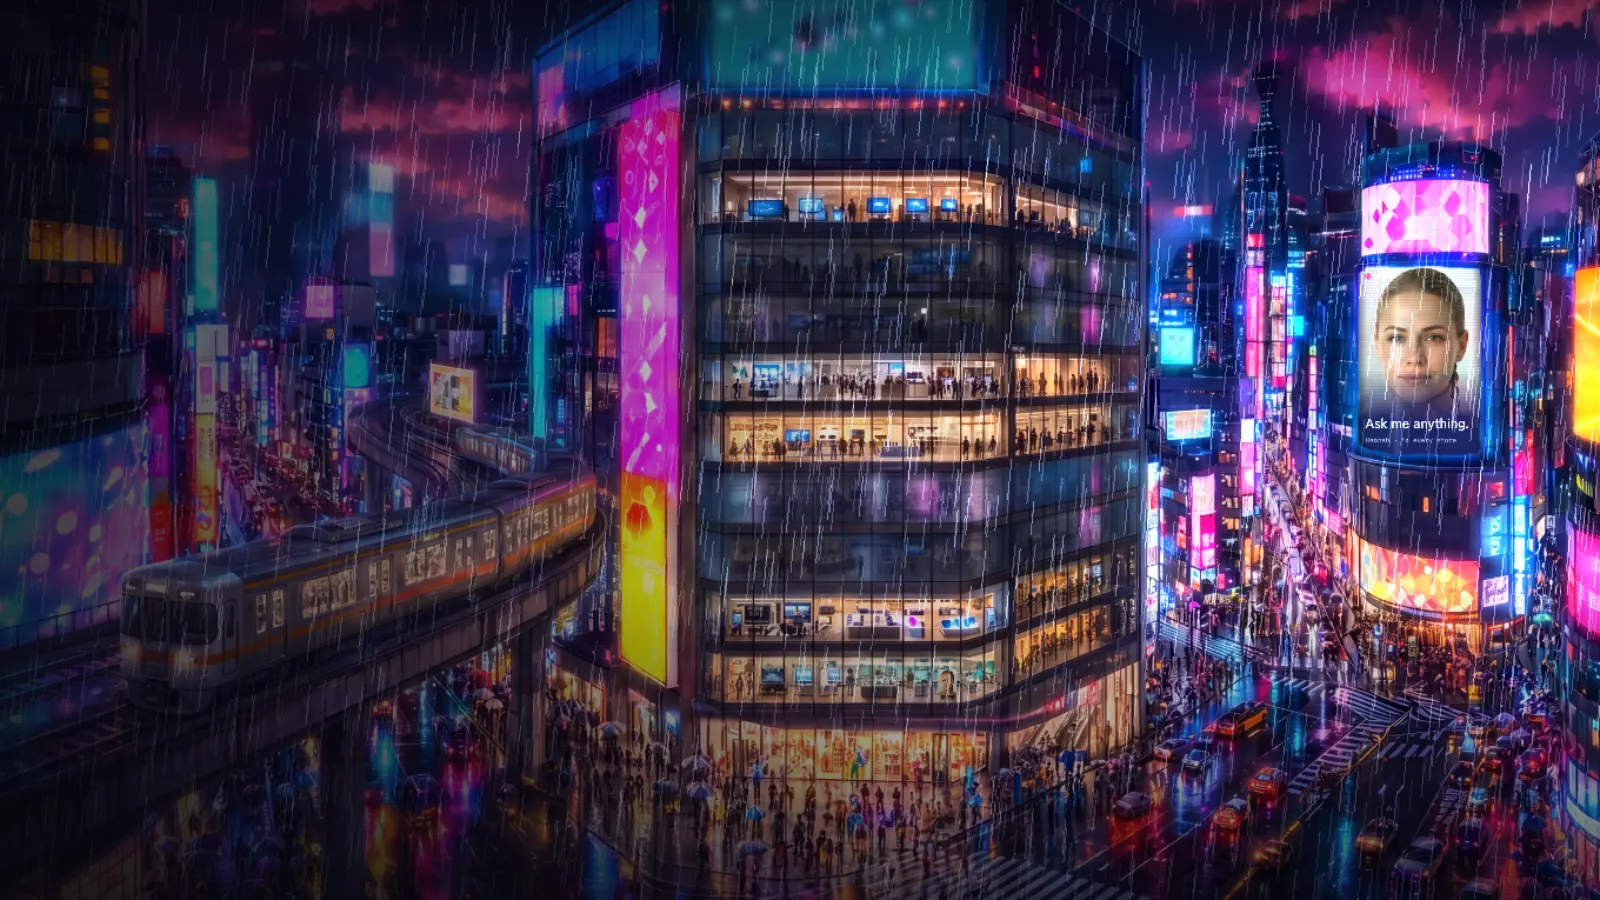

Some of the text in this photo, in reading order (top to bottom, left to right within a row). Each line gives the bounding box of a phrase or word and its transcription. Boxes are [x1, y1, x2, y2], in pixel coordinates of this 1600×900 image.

[1365, 417, 1469, 432] Ask me anything.
